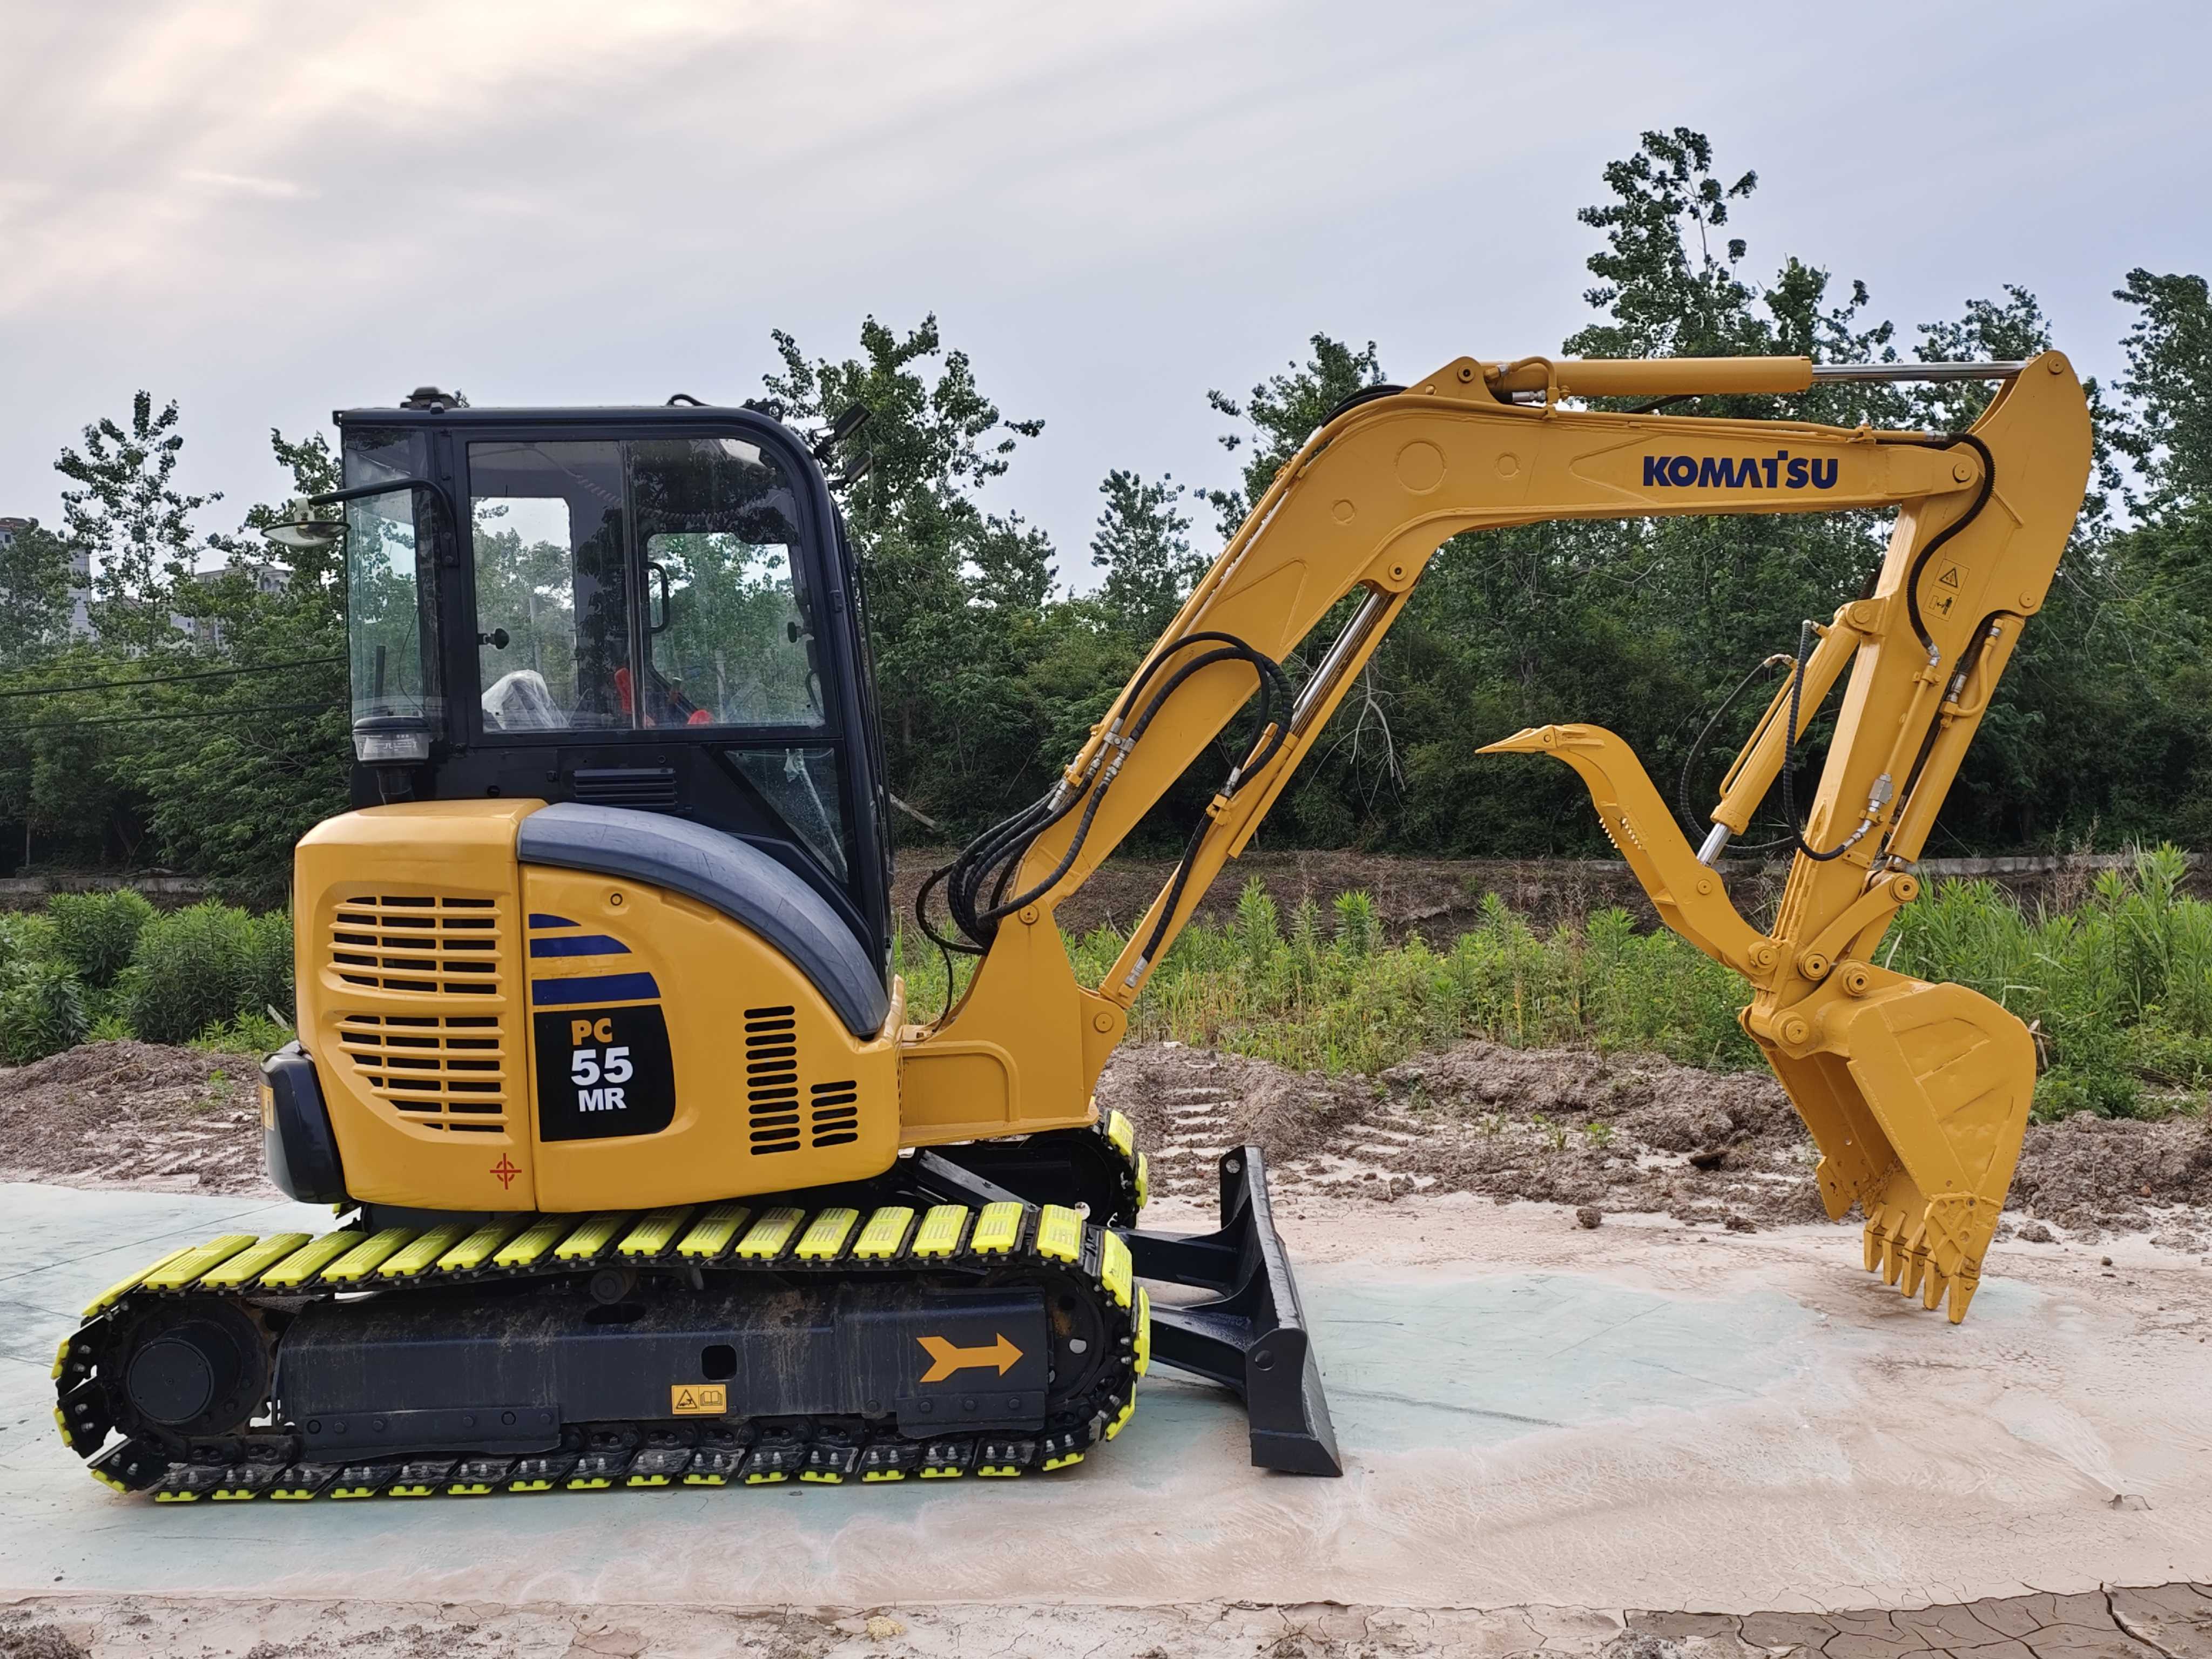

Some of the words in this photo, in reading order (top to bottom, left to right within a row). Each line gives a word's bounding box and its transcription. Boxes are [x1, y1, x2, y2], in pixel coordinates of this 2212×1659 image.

[1643, 450, 1838, 489] KOMATSU
[571, 1018, 613, 1046] PC
[571, 1047, 633, 1085] 55
[578, 1088, 627, 1112] MR
